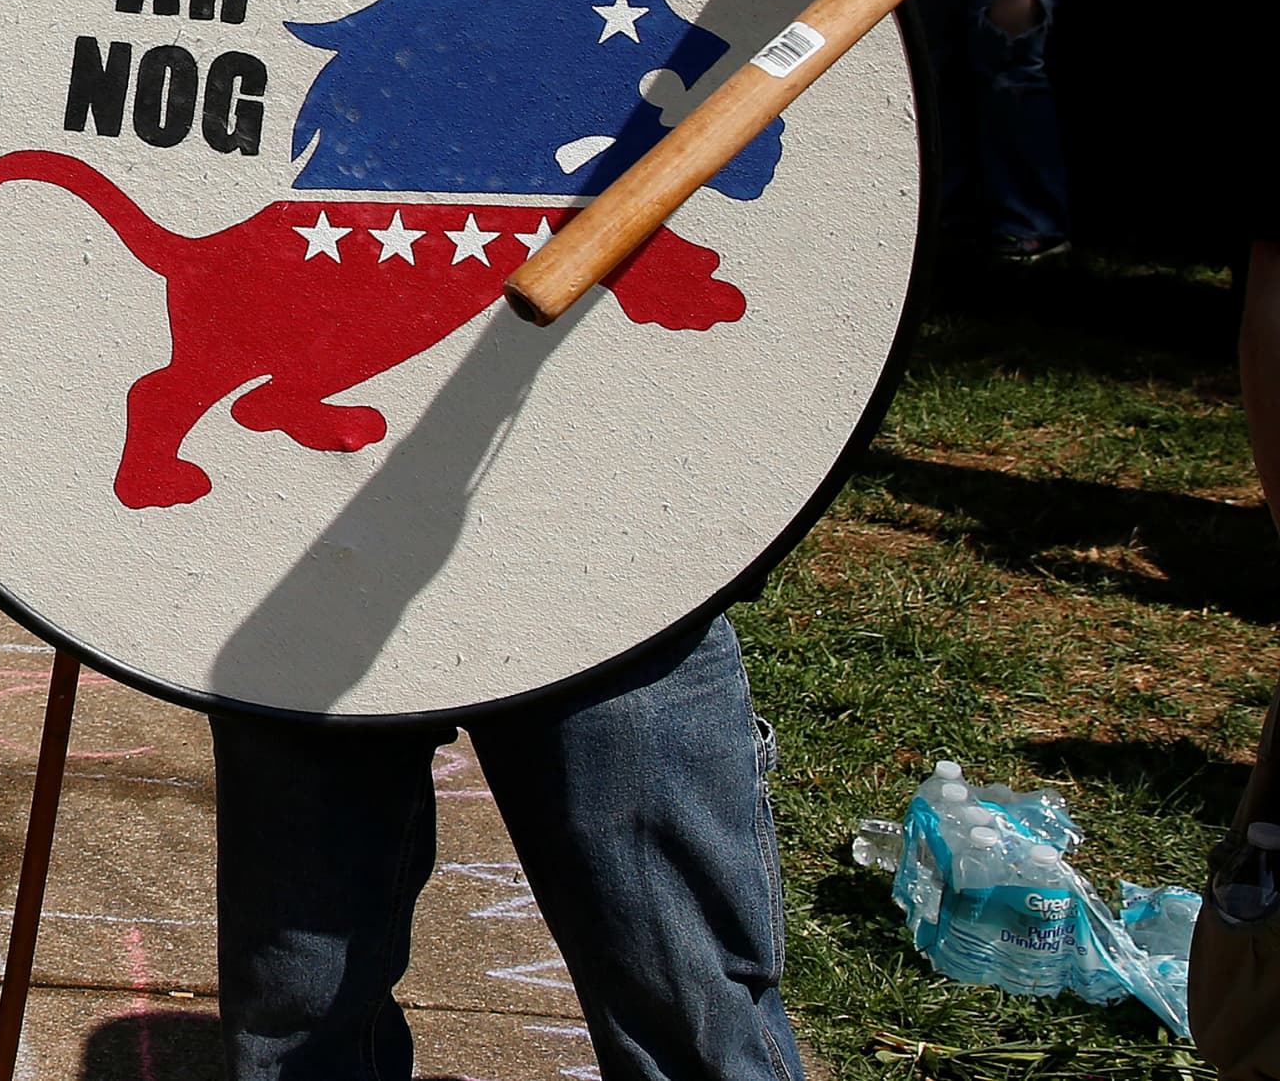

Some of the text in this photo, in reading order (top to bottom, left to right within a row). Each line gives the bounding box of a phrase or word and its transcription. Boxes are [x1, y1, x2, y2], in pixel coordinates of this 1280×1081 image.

[64, 36, 268, 156] NOG
[1025, 892, 1077, 912] Grea
[1000, 929, 1061, 954] Drinking
